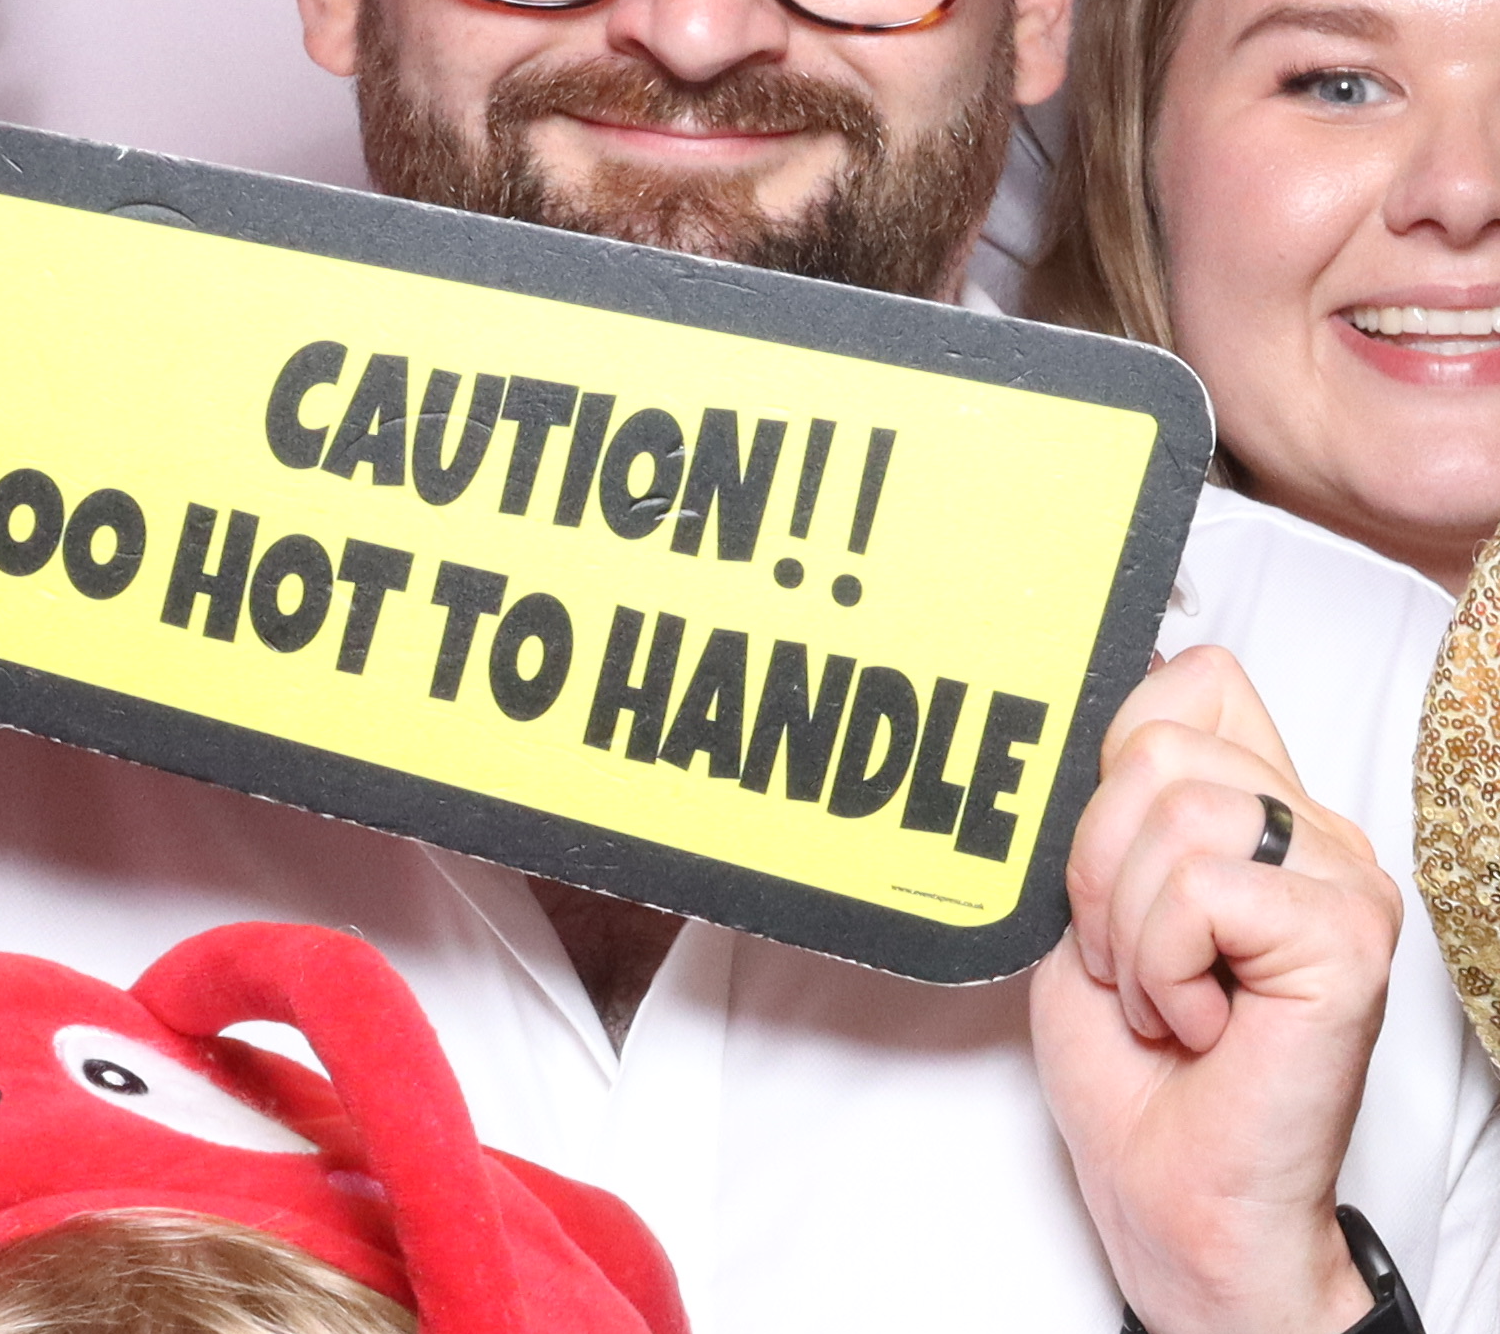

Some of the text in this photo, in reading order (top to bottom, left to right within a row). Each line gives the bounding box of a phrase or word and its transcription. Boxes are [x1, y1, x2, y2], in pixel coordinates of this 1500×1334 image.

[263, 338, 898, 609] CAUTION!!
[159, 501, 414, 675] HOT
[427, 558, 576, 722] TO
[582, 604, 1051, 865] HANDLE
